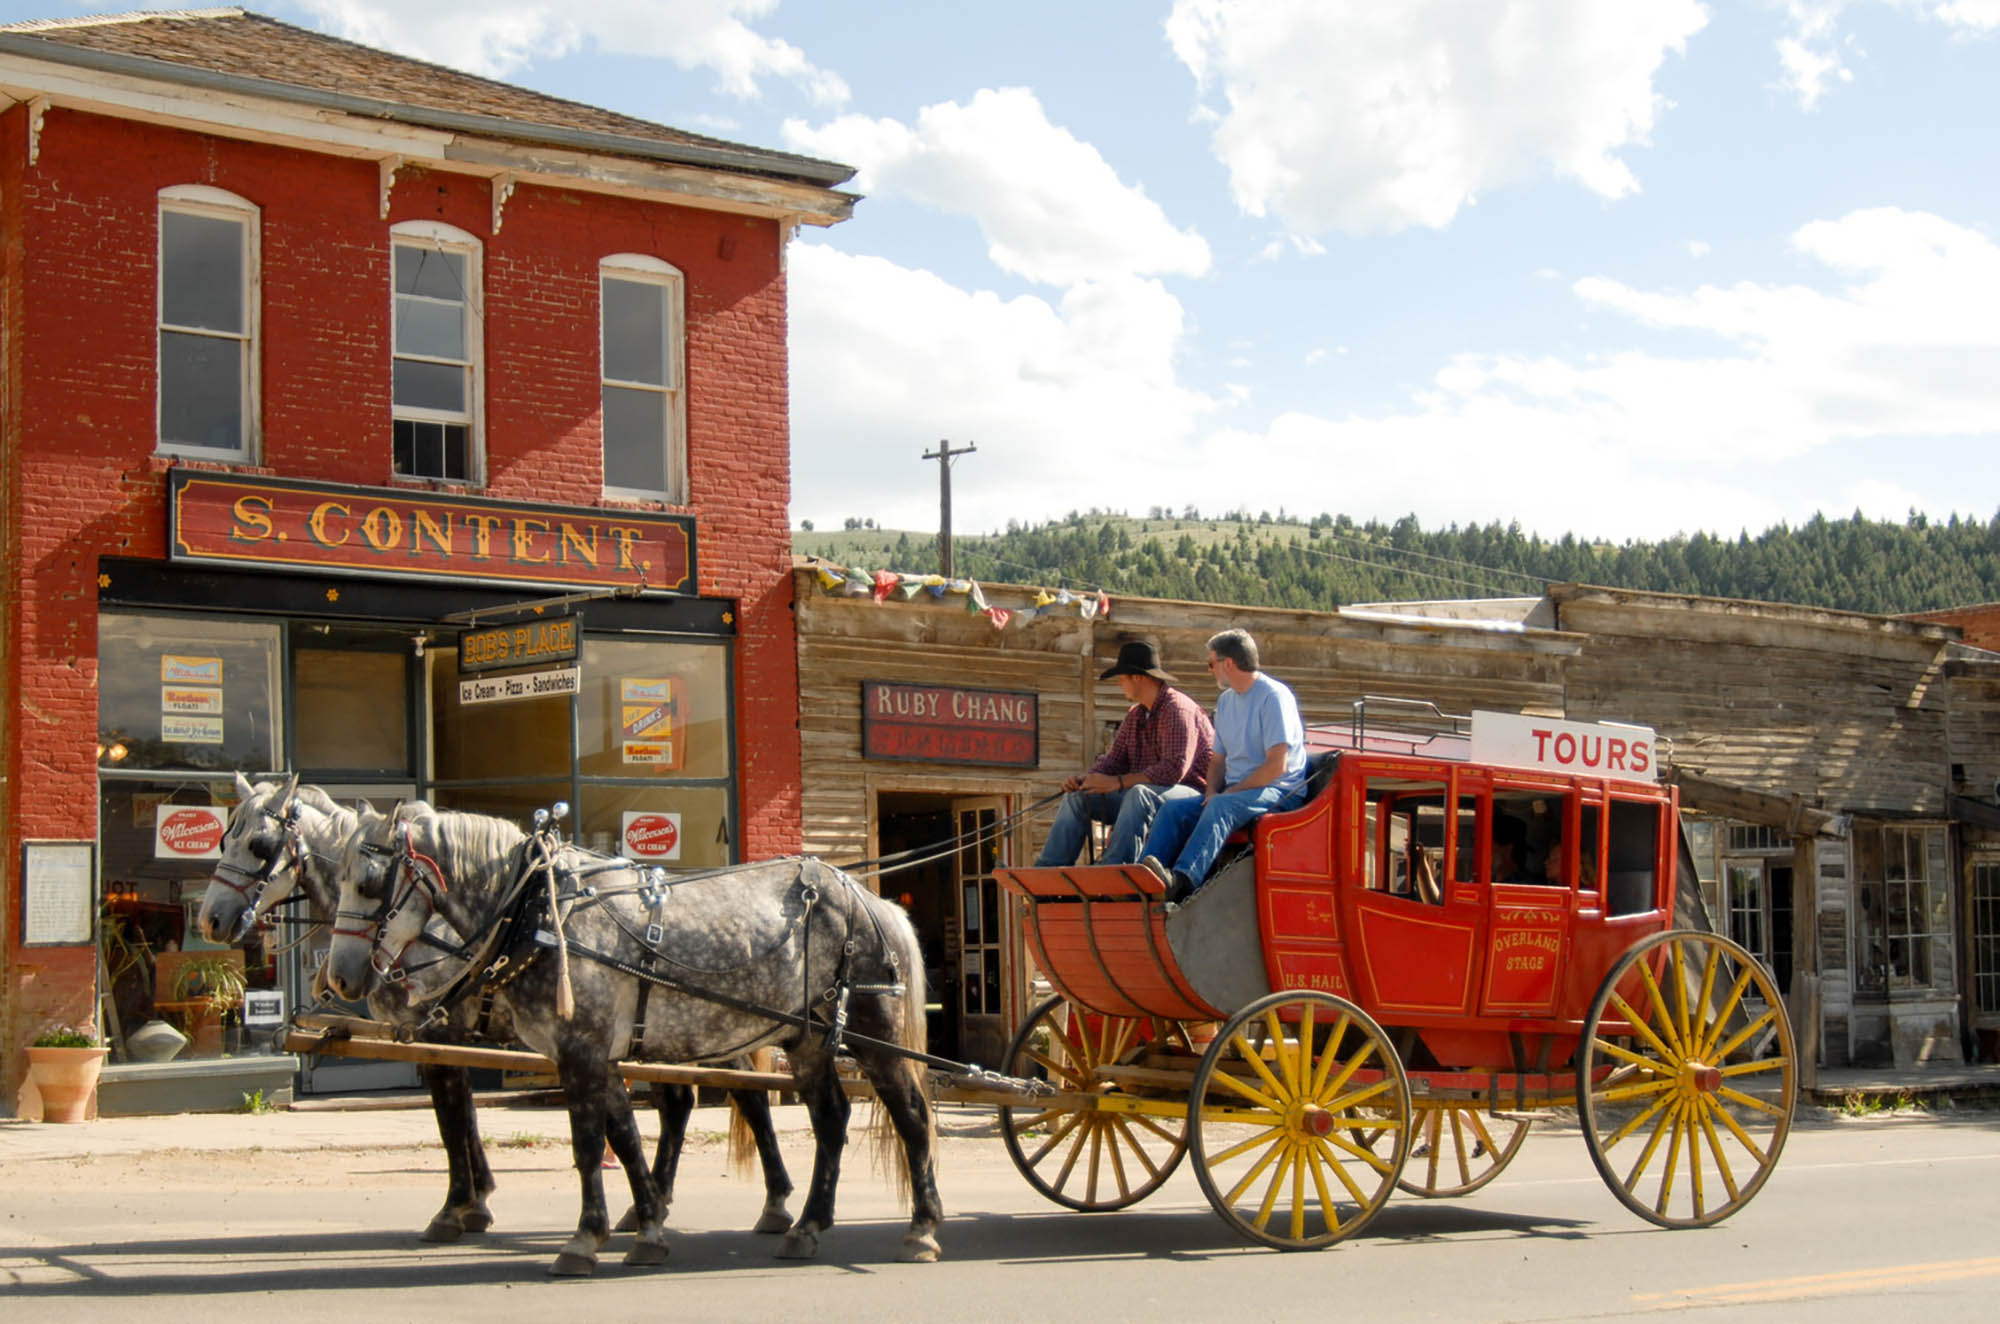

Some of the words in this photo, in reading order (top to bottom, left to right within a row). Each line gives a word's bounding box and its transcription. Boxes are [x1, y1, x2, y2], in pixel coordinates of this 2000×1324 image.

[232, 495, 288, 542] S.
[309, 502, 652, 571] CONTENT.
[461, 684, 473, 701] Ice
[475, 682, 496, 700] Cream
[505, 679, 524, 697] Pizza
[532, 673, 575, 694] Sandwiches
[877, 686, 941, 717] RUBY
[951, 690, 1029, 724] CHANG
[1532, 729, 1649, 773] TOURS
[173, 841, 185, 849] ICE
[186, 841, 211, 849] CREAM
[1495, 931, 1560, 952] OVERLAND
[1506, 956, 1545, 972] STAGE
[1311, 973, 1344, 990] MAIL
